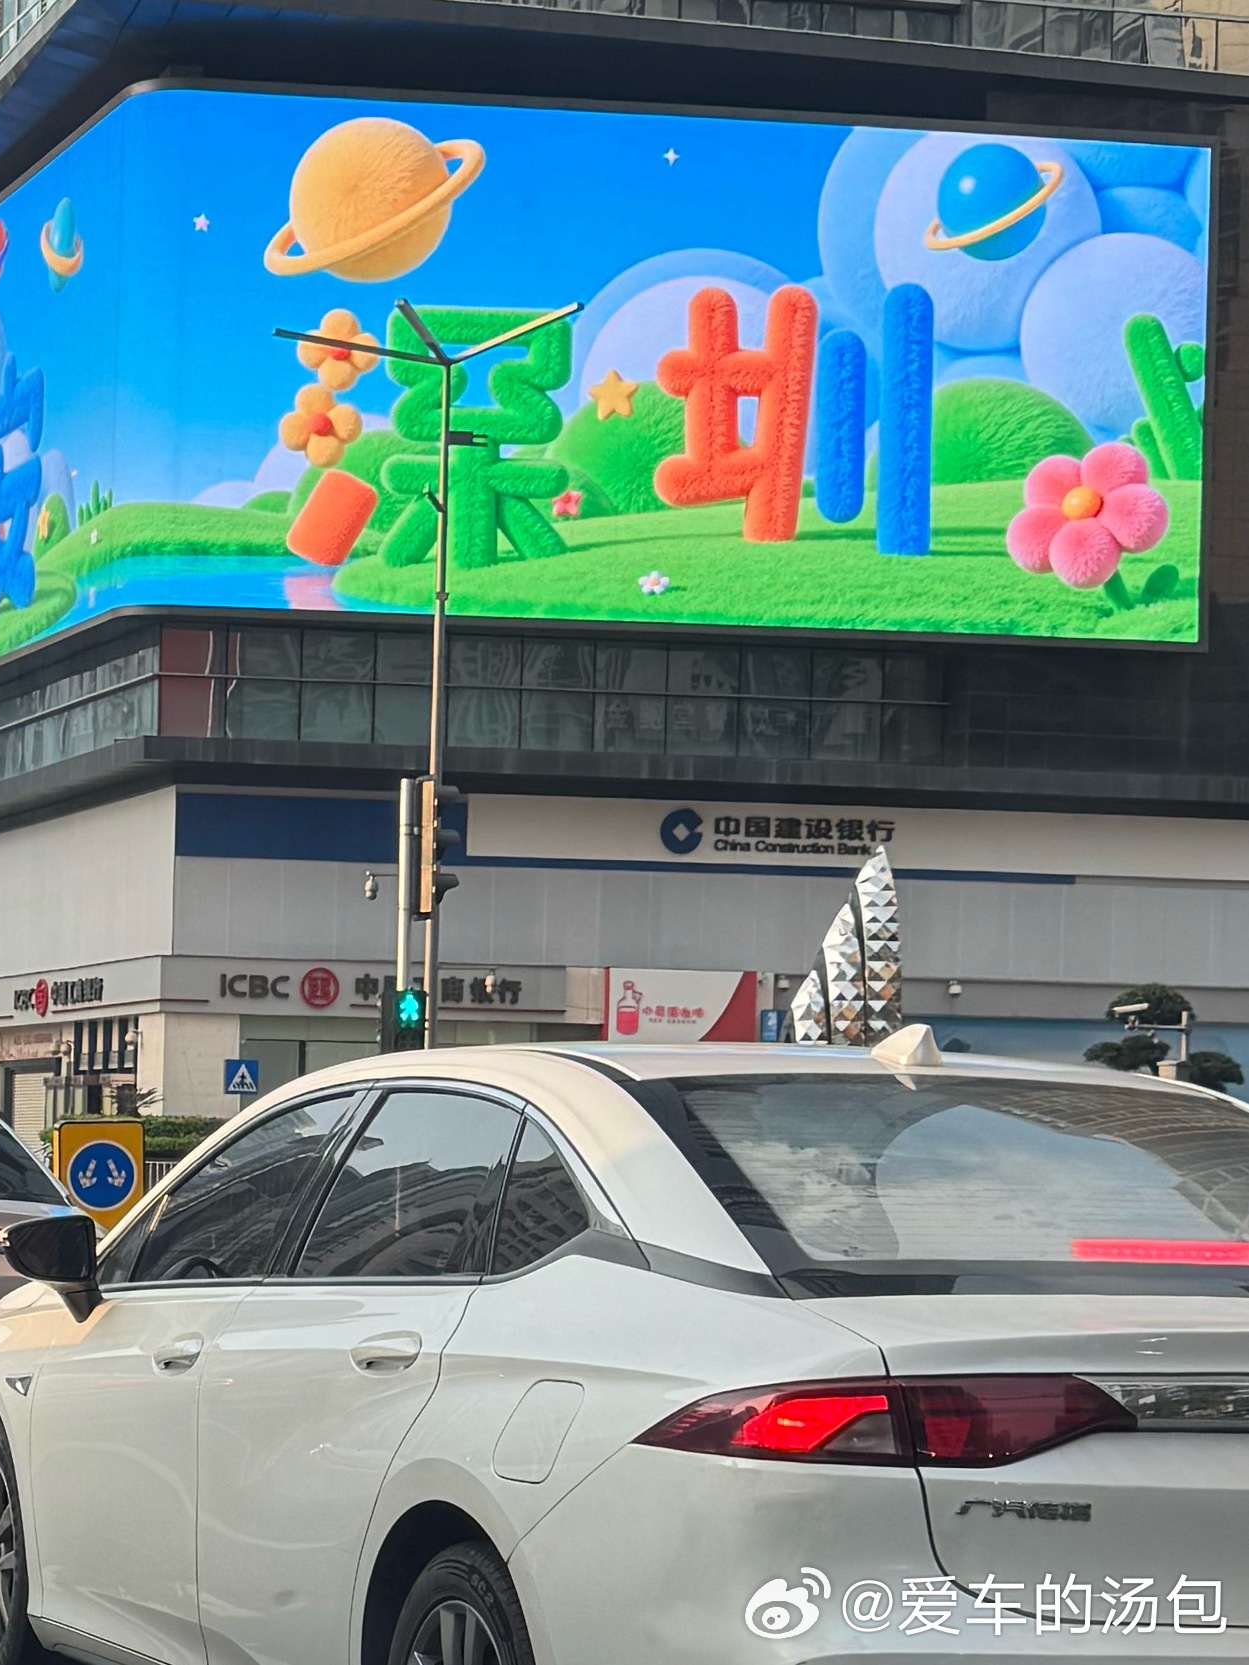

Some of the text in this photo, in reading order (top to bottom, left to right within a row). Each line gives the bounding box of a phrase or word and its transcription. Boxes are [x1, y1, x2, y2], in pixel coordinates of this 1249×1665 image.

[713, 815, 896, 843] 中国建设银行
[713, 838, 872, 856] China Construction Bank
[219, 972, 523, 1005] ICBC 中商银行
